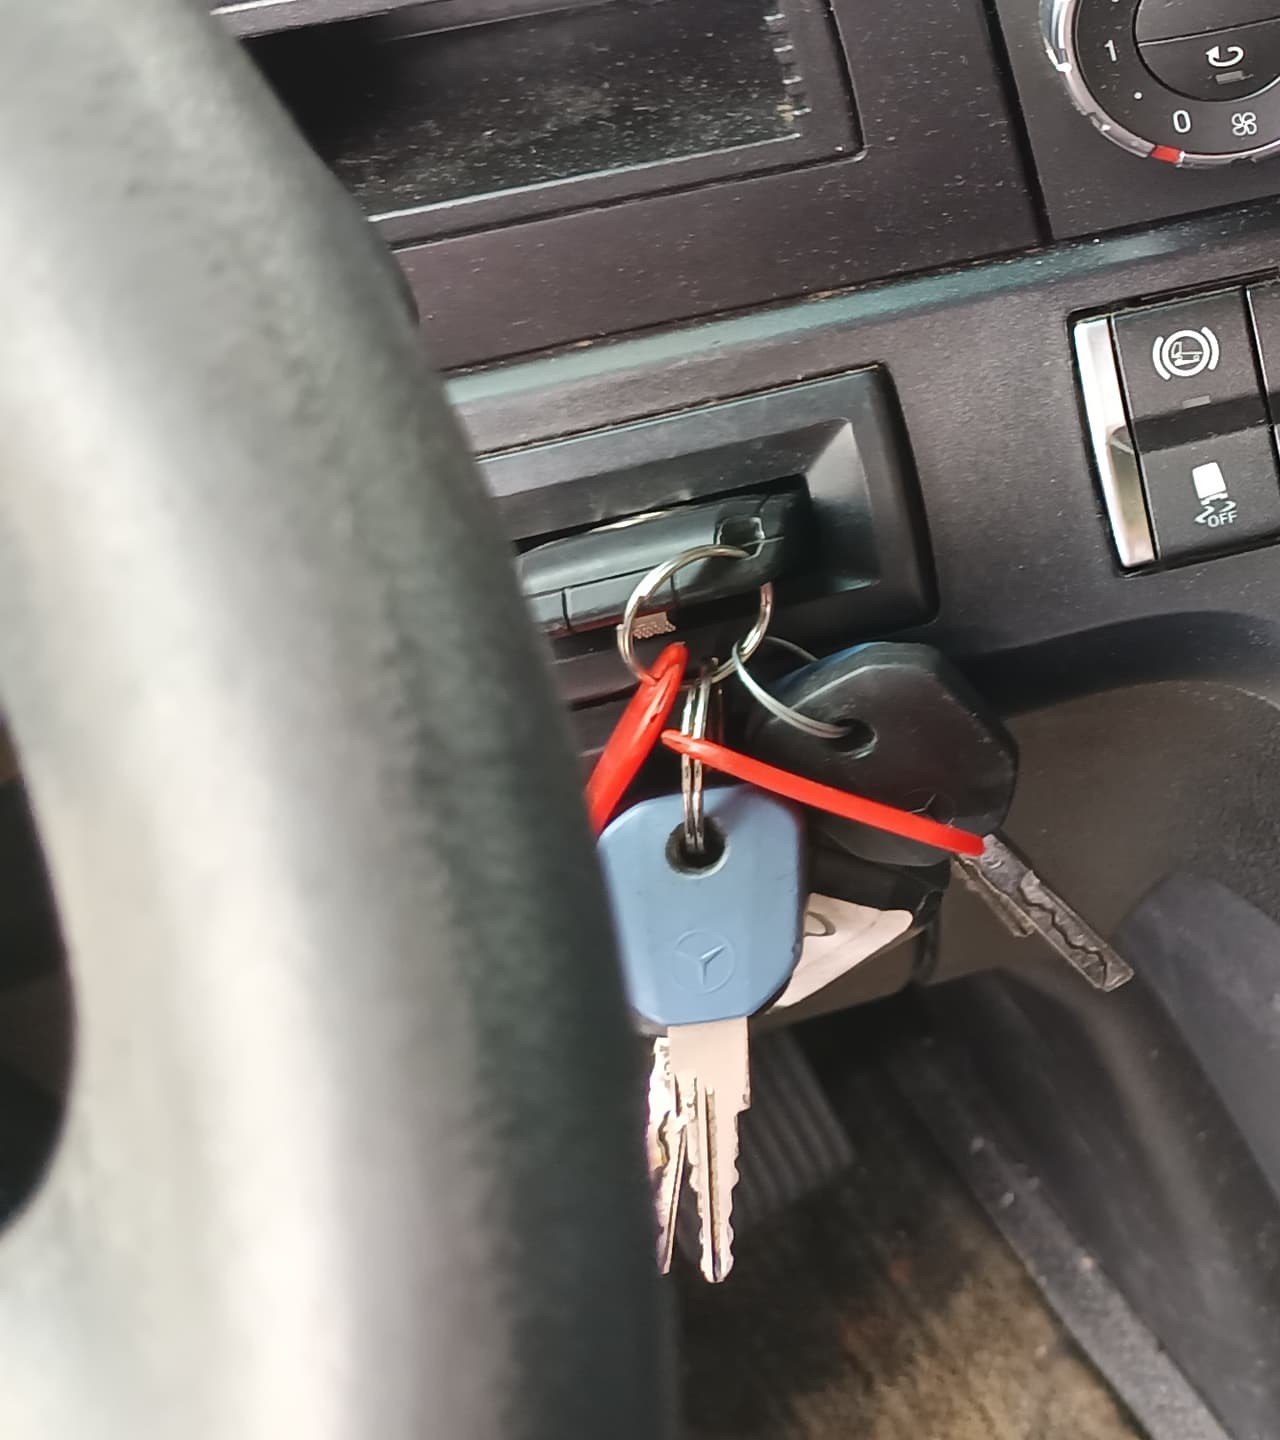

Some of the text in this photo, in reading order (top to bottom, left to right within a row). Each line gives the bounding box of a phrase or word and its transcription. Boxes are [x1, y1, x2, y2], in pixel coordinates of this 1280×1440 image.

[1105, 39, 1117, 62] 1
[1173, 110, 1191, 133] 0
[1207, 509, 1238, 528] OFF
